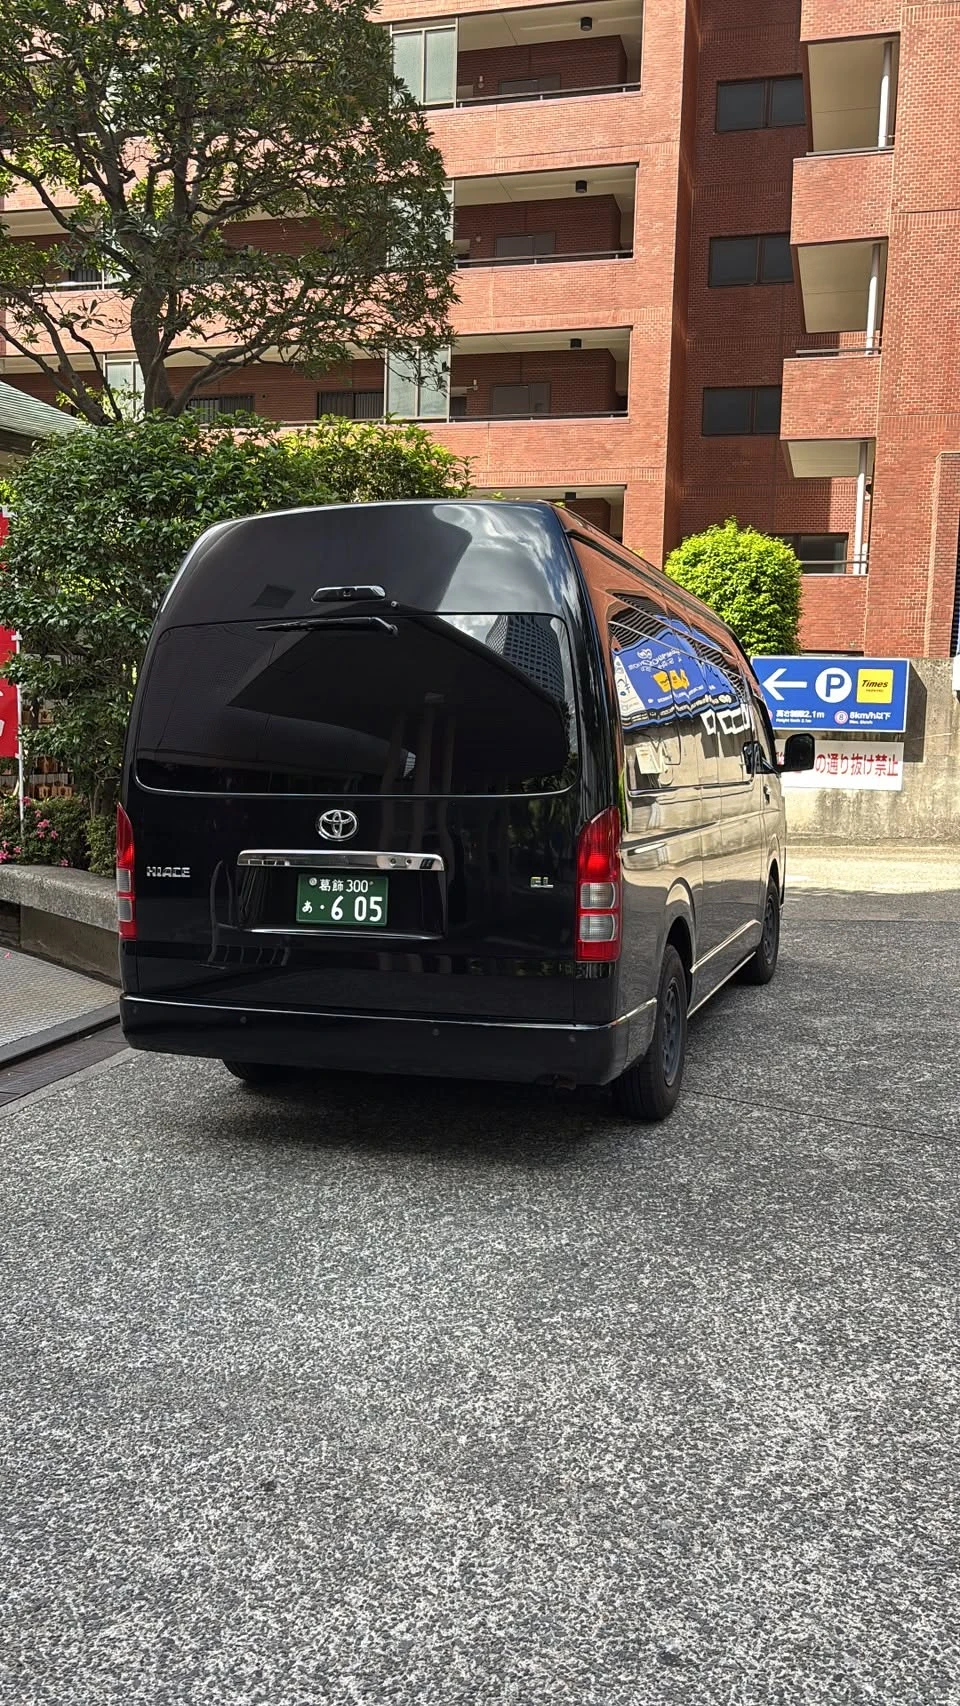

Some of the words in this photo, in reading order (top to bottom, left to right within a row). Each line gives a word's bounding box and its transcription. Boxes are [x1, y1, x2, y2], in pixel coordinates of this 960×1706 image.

[825, 673, 845, 697] P
[862, 679, 888, 688] Times
[776, 753, 898, 776] の通り抜け禁止
[146, 866, 190, 877] HIACE
[319, 879, 344, 892] 葛飾
[345, 879, 368, 892] 300
[302, 900, 313, 913] あ
